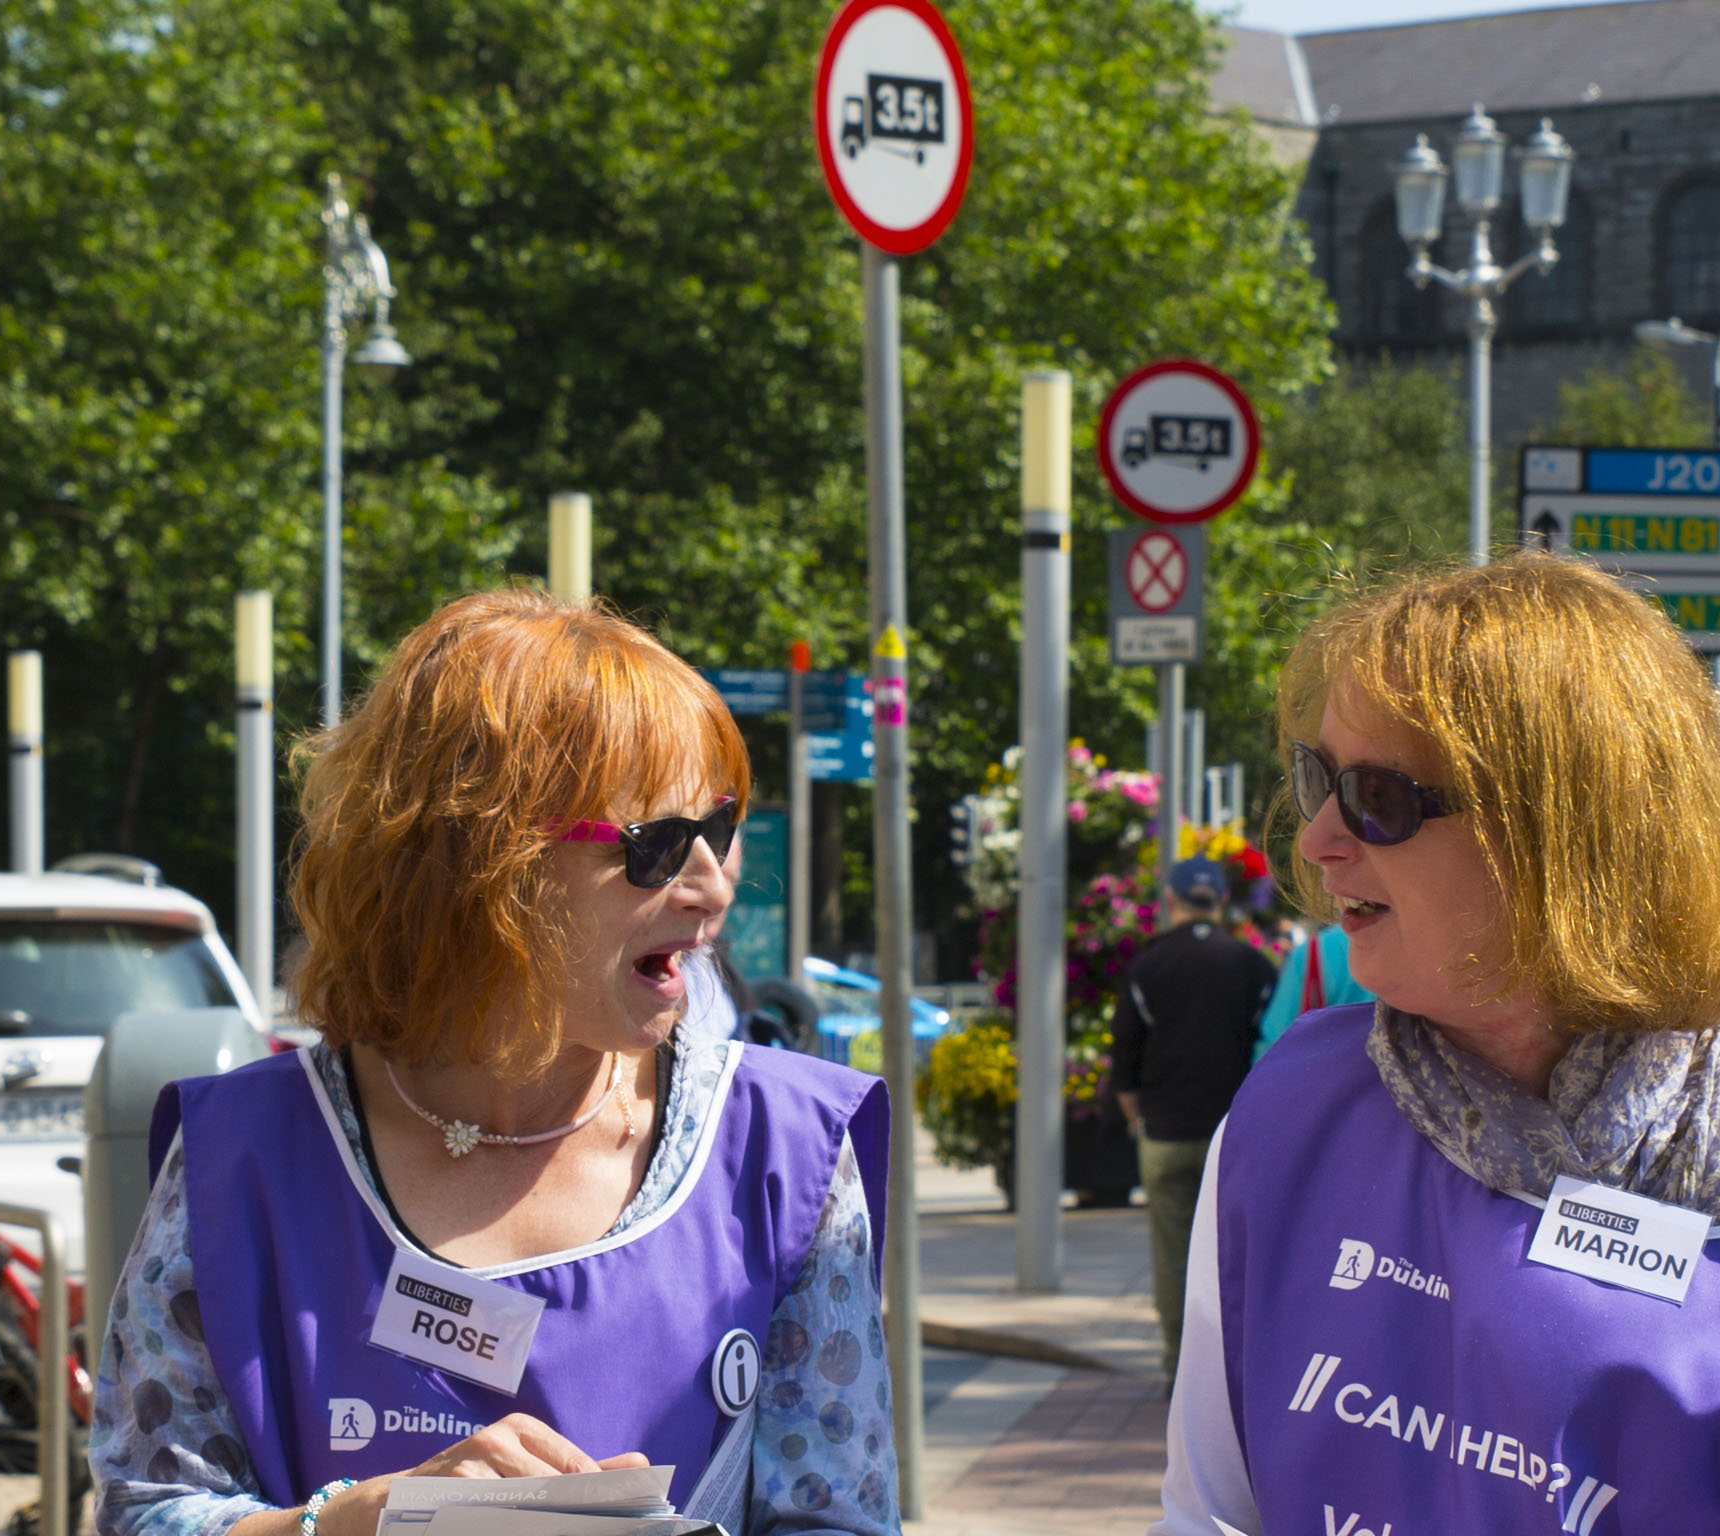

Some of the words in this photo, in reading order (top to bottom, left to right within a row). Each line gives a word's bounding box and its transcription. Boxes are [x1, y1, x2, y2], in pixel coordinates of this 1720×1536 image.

[875, 83, 939, 133] 3.5t
[1159, 419, 1226, 450] 3.5t
[1569, 1203, 1636, 1233] LIBERTIES
[1554, 1224, 1688, 1280] MARION
[405, 1280, 470, 1314] LIBERTIES
[411, 1309, 500, 1361] ROSE
[1334, 1382, 1445, 1452] CAN
